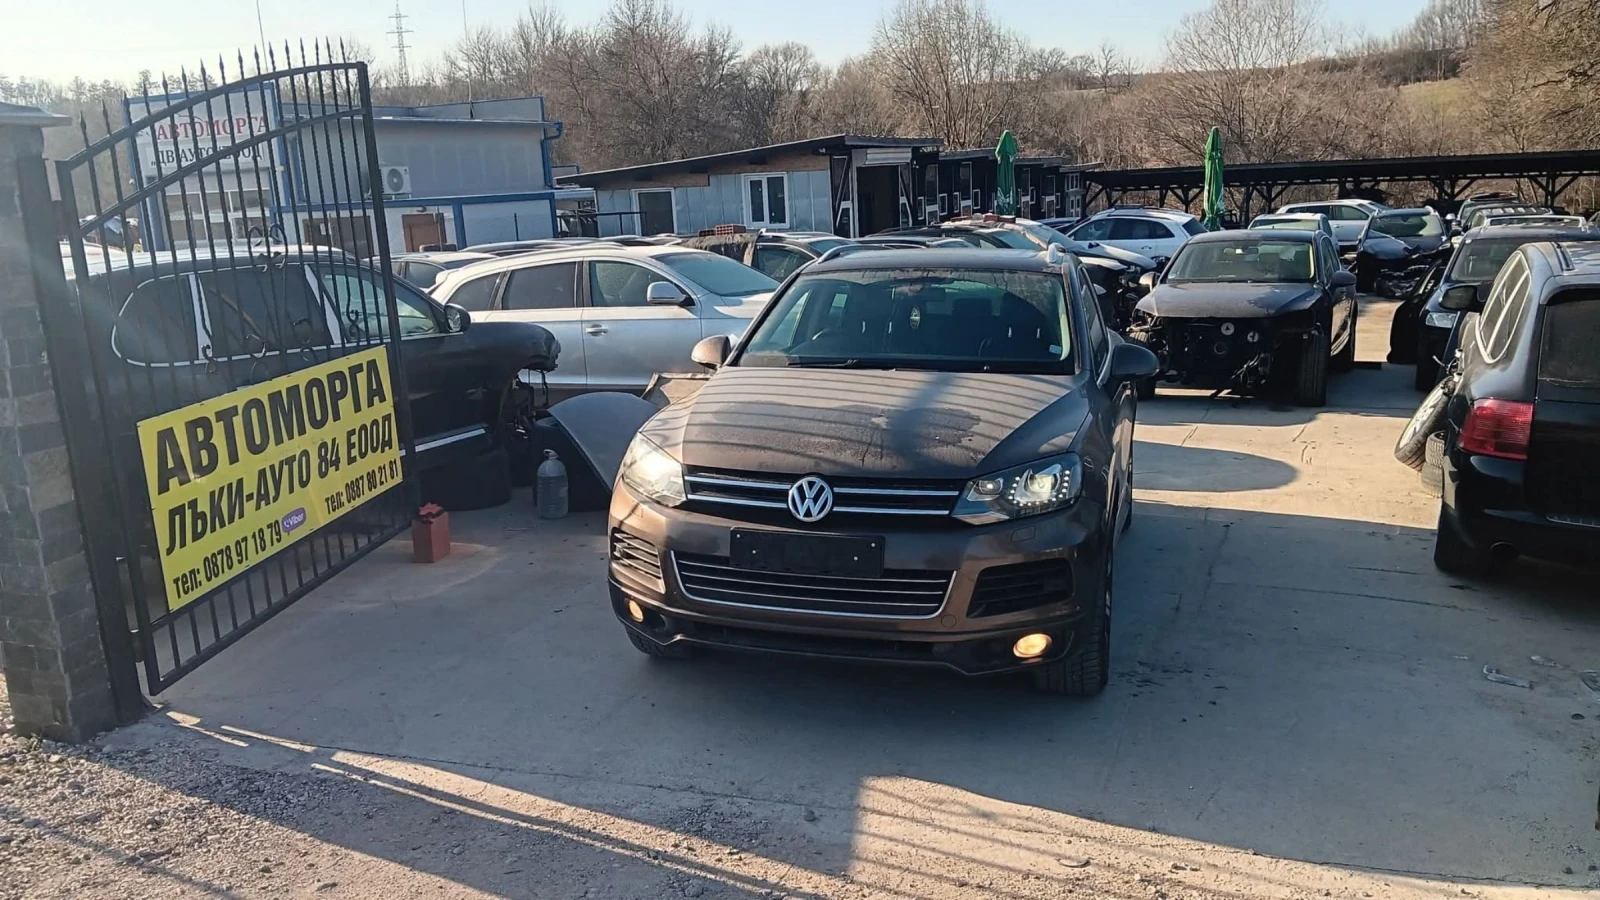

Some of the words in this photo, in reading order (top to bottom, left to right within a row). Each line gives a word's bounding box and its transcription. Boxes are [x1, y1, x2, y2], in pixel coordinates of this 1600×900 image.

[157, 116, 267, 140] АВТОМОРГА
[156, 358, 387, 496] АВТОМОРГА
[166, 449, 311, 556] ЛЪКИ-АУТО
[318, 437, 341, 479] 84
[346, 413, 393, 466] ЕООД
[325, 491, 345, 515] тел:
[345, 475, 365, 504] 0887
[366, 469, 378, 492] 80
[378, 464, 388, 486] 21
[389, 459, 399, 480] 81
[288, 513, 304, 527] Viber
[173, 568, 203, 600] тел:
[203, 545, 234, 582] 0878
[235, 536, 249, 565] 97
[251, 528, 267, 555] 18
[267, 519, 282, 547] 79
